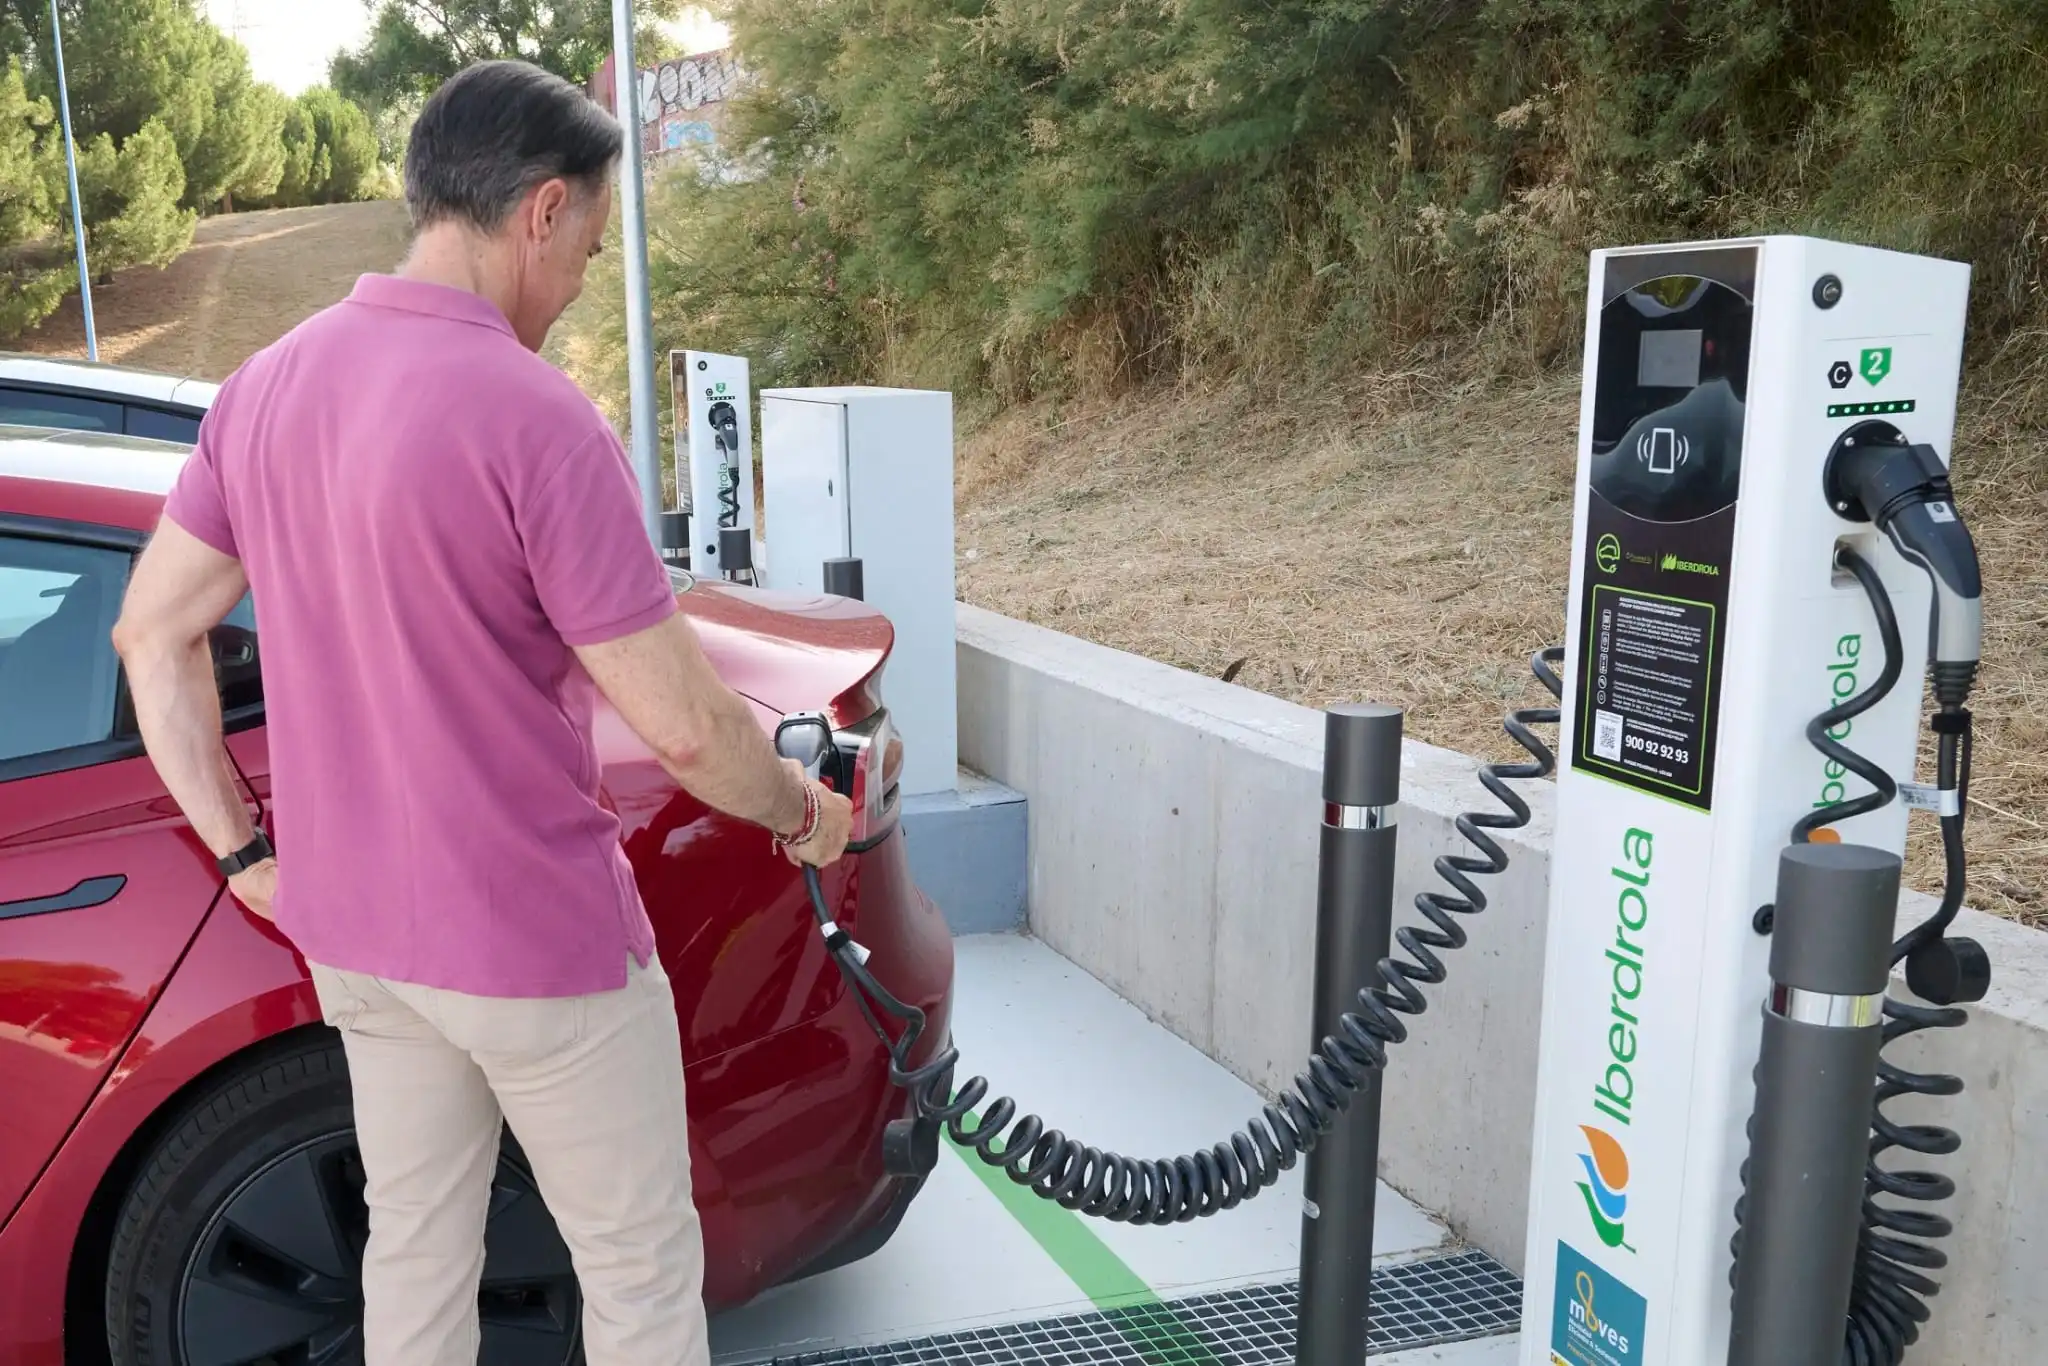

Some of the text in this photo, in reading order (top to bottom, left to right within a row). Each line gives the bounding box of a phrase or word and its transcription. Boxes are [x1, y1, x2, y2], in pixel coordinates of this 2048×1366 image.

[1834, 366, 1847, 383] C
[1868, 351, 1883, 375] 2
[1676, 560, 1719, 575] IBERDROLA
[1625, 734, 1689, 764] 900 92 92 93
[1594, 827, 1653, 1125] Iberdrola
[1569, 1296, 1629, 1354] moves
